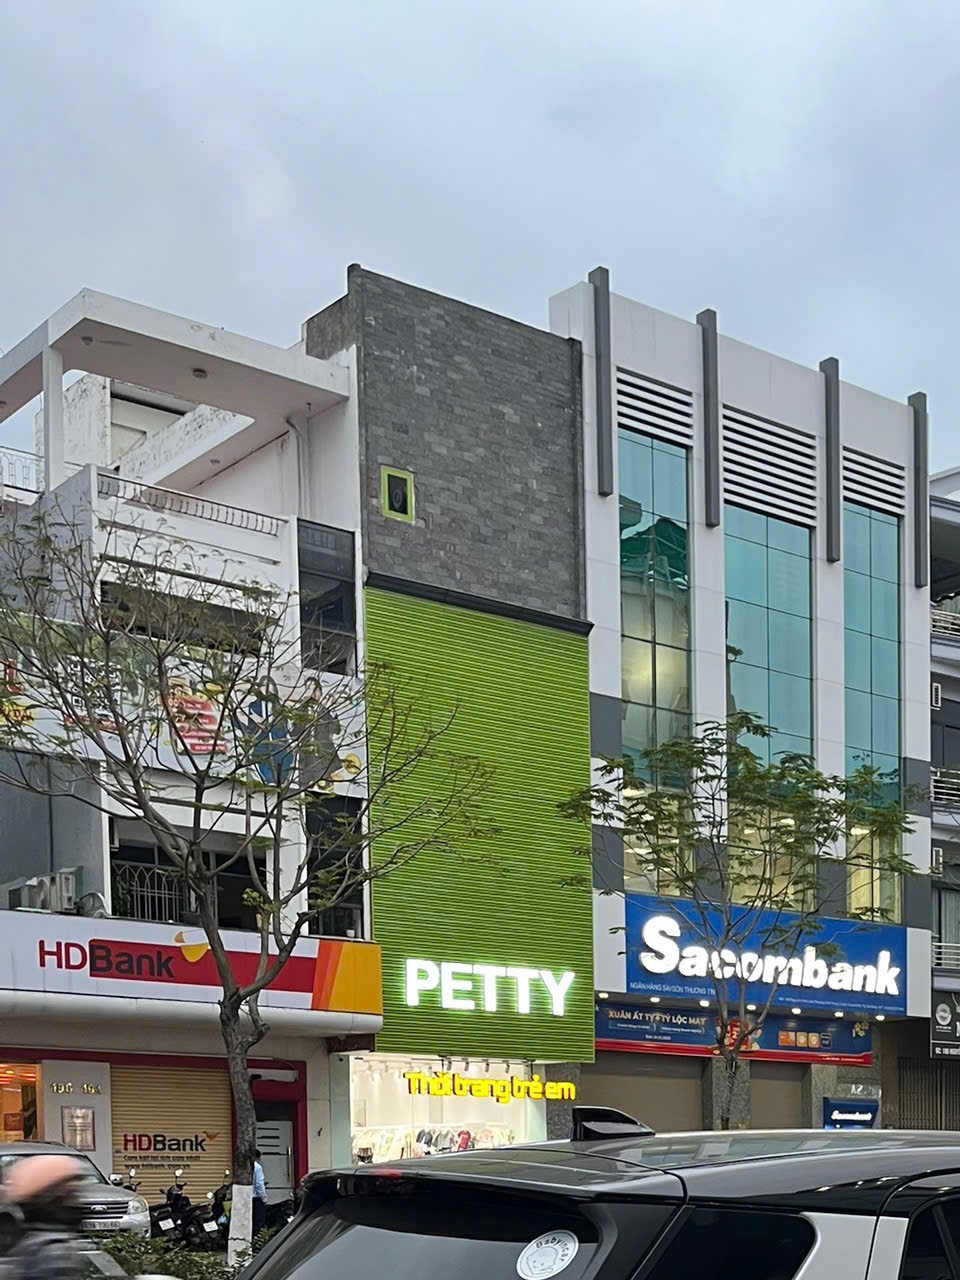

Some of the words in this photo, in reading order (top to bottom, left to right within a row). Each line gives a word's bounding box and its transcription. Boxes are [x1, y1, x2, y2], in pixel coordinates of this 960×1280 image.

[39, 939, 175, 978] HDBank
[639, 915, 901, 996] Sacombank
[405, 958, 576, 1016] PETTY
[545, 1081, 576, 1100] em
[123, 1133, 206, 1151] HDBank
